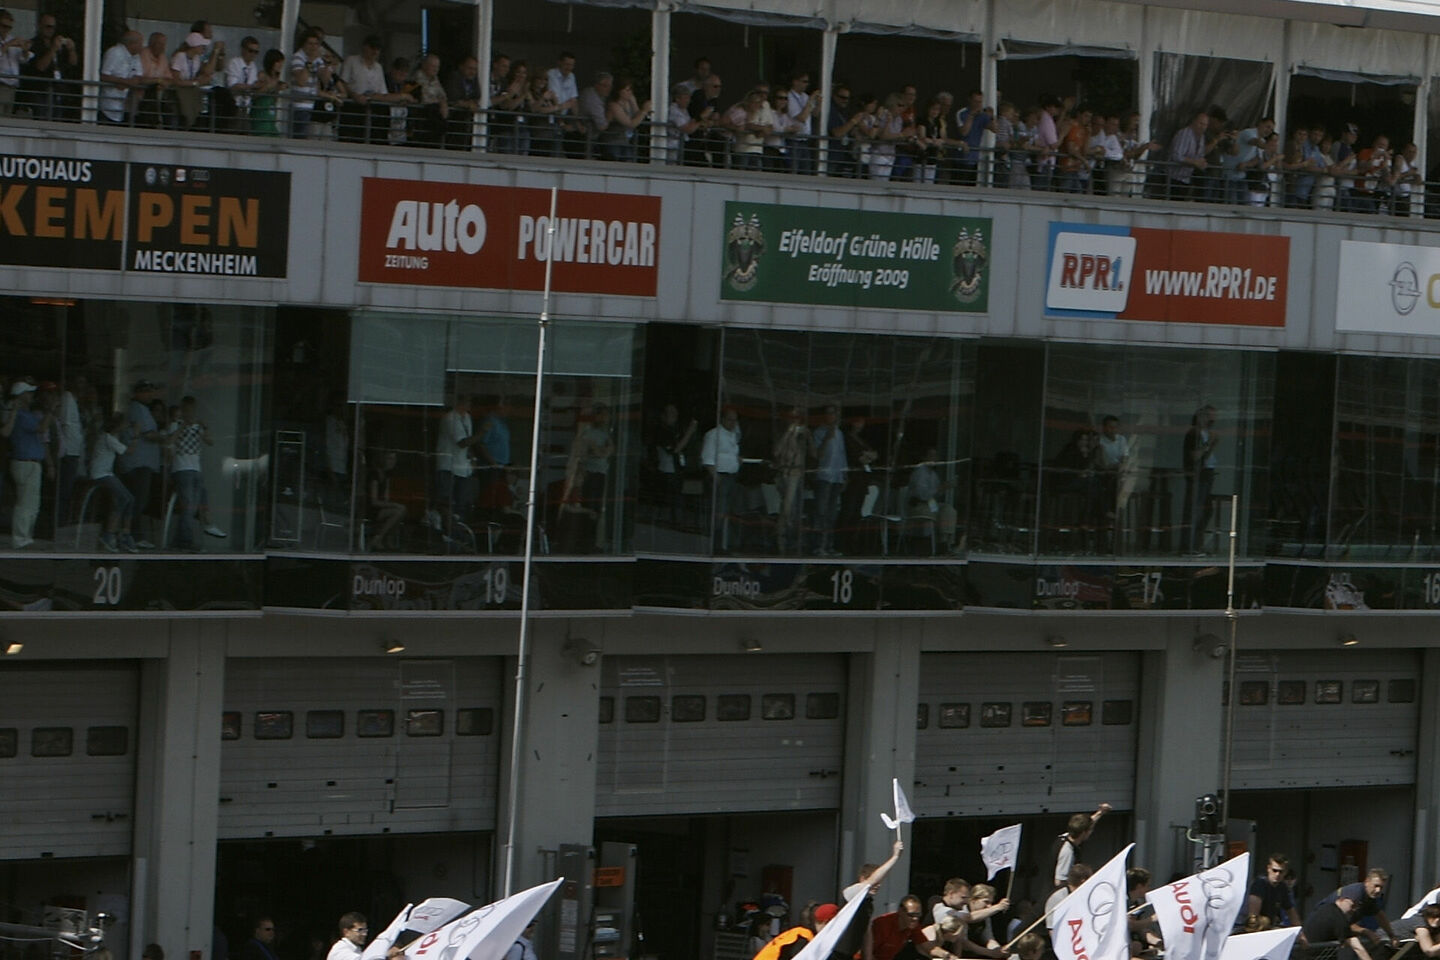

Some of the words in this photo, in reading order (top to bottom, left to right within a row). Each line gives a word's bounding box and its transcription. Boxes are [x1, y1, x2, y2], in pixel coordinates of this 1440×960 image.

[386, 199, 487, 255] Auto
[517, 213, 655, 268] POWERCAR
[779, 229, 848, 260] Eifeldorf
[850, 232, 897, 259] Grüne
[901, 235, 941, 261] Hölle
[134, 250, 257, 275] MECKENHEIM
[384, 254, 429, 270] ZEITUNG
[808, 264, 873, 289] Eröffnung
[874, 268, 910, 289] 2009
[1060, 252, 1124, 291] RPR1.
[1145, 265, 1278, 300] WWW.RPR1.DE
[93, 566, 122, 605] 20
[353, 573, 405, 599] Dunlop
[483, 567, 508, 604] 19
[713, 576, 760, 600] Dunlop
[830, 569, 854, 604] 18
[1036, 577, 1079, 600] Dunlop
[1141, 572, 1163, 603] 17
[1169, 881, 1199, 934] Audi
